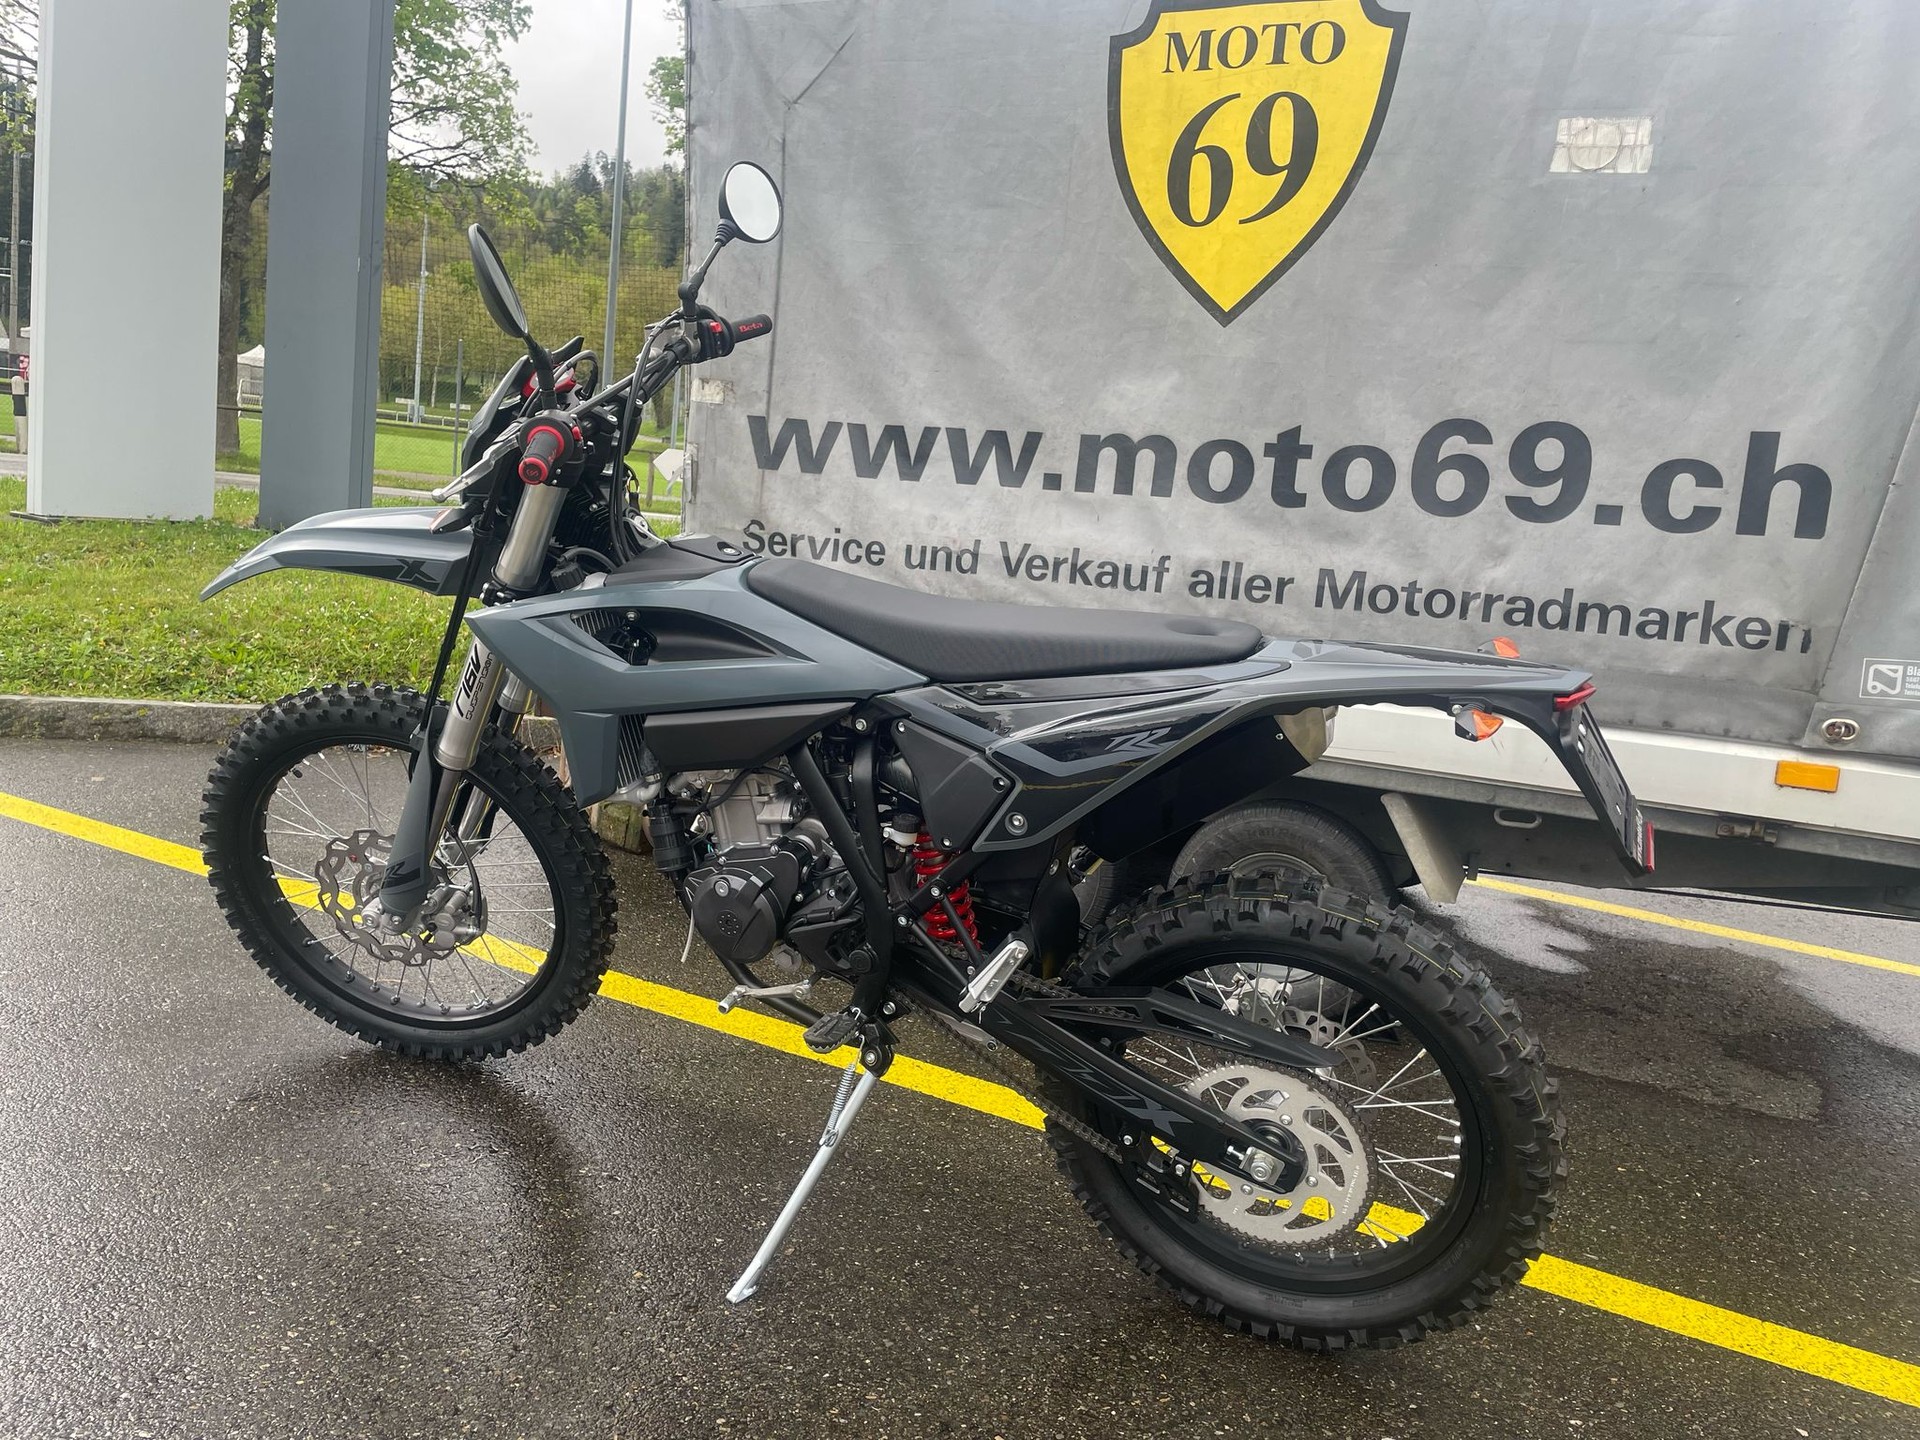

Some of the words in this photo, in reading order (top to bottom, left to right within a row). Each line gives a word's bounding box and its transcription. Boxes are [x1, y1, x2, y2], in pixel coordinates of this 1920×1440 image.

[1161, 20, 1346, 73] MOTO
[1166, 91, 1320, 228] 69
[739, 322, 764, 333] Beta
[747, 415, 1833, 540] www.moto69.ch
[742, 519, 886, 567] Service
[904, 539, 981, 575] und
[1000, 541, 1170, 594] Verkauf
[1188, 560, 1295, 605] aller
[1314, 567, 1812, 654] Motorradmarken
